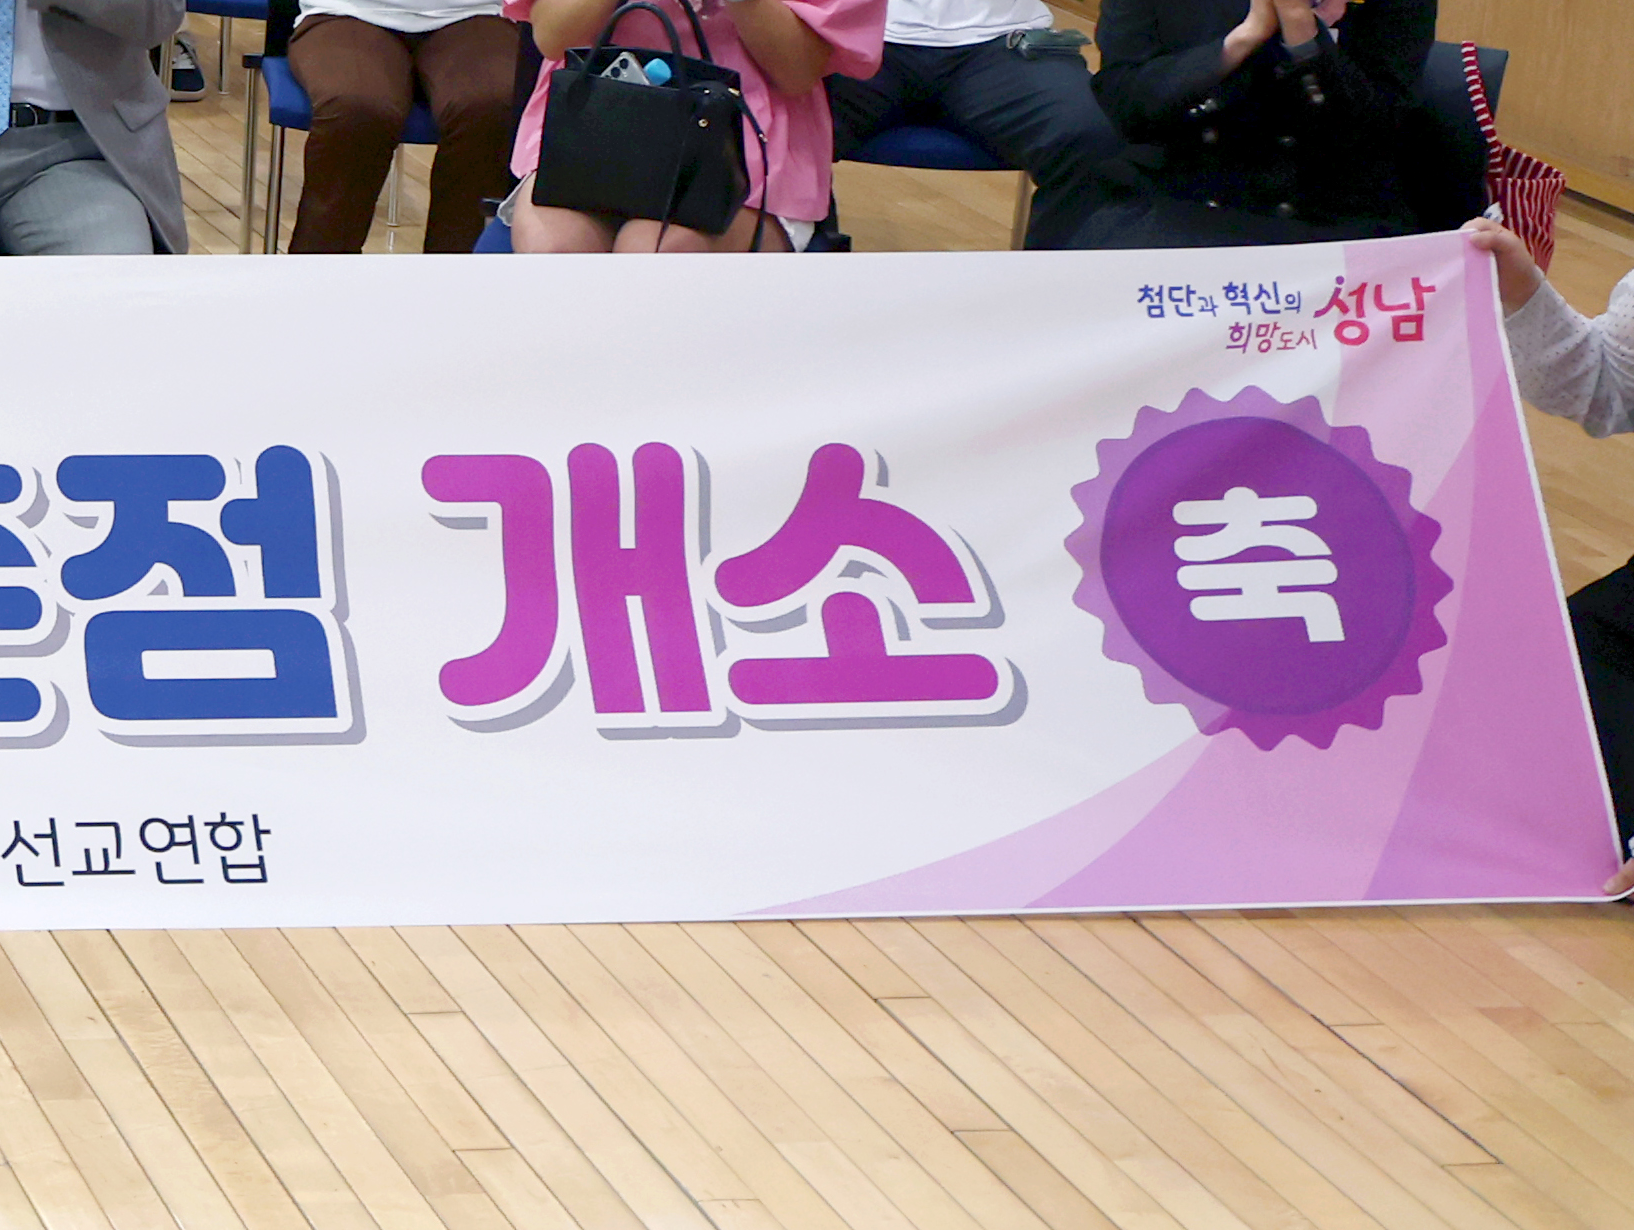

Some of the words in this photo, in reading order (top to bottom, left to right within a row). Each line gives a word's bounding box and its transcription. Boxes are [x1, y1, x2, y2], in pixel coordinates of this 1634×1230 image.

[1137, 284, 1218, 318] 첨단과
[1222, 281, 1301, 315] 혁신의
[1312, 275, 1437, 346] 성남
[1226, 321, 1318, 353] 희망도시
[420, 441, 999, 714] 개소
[1172, 486, 1345, 643] 축
